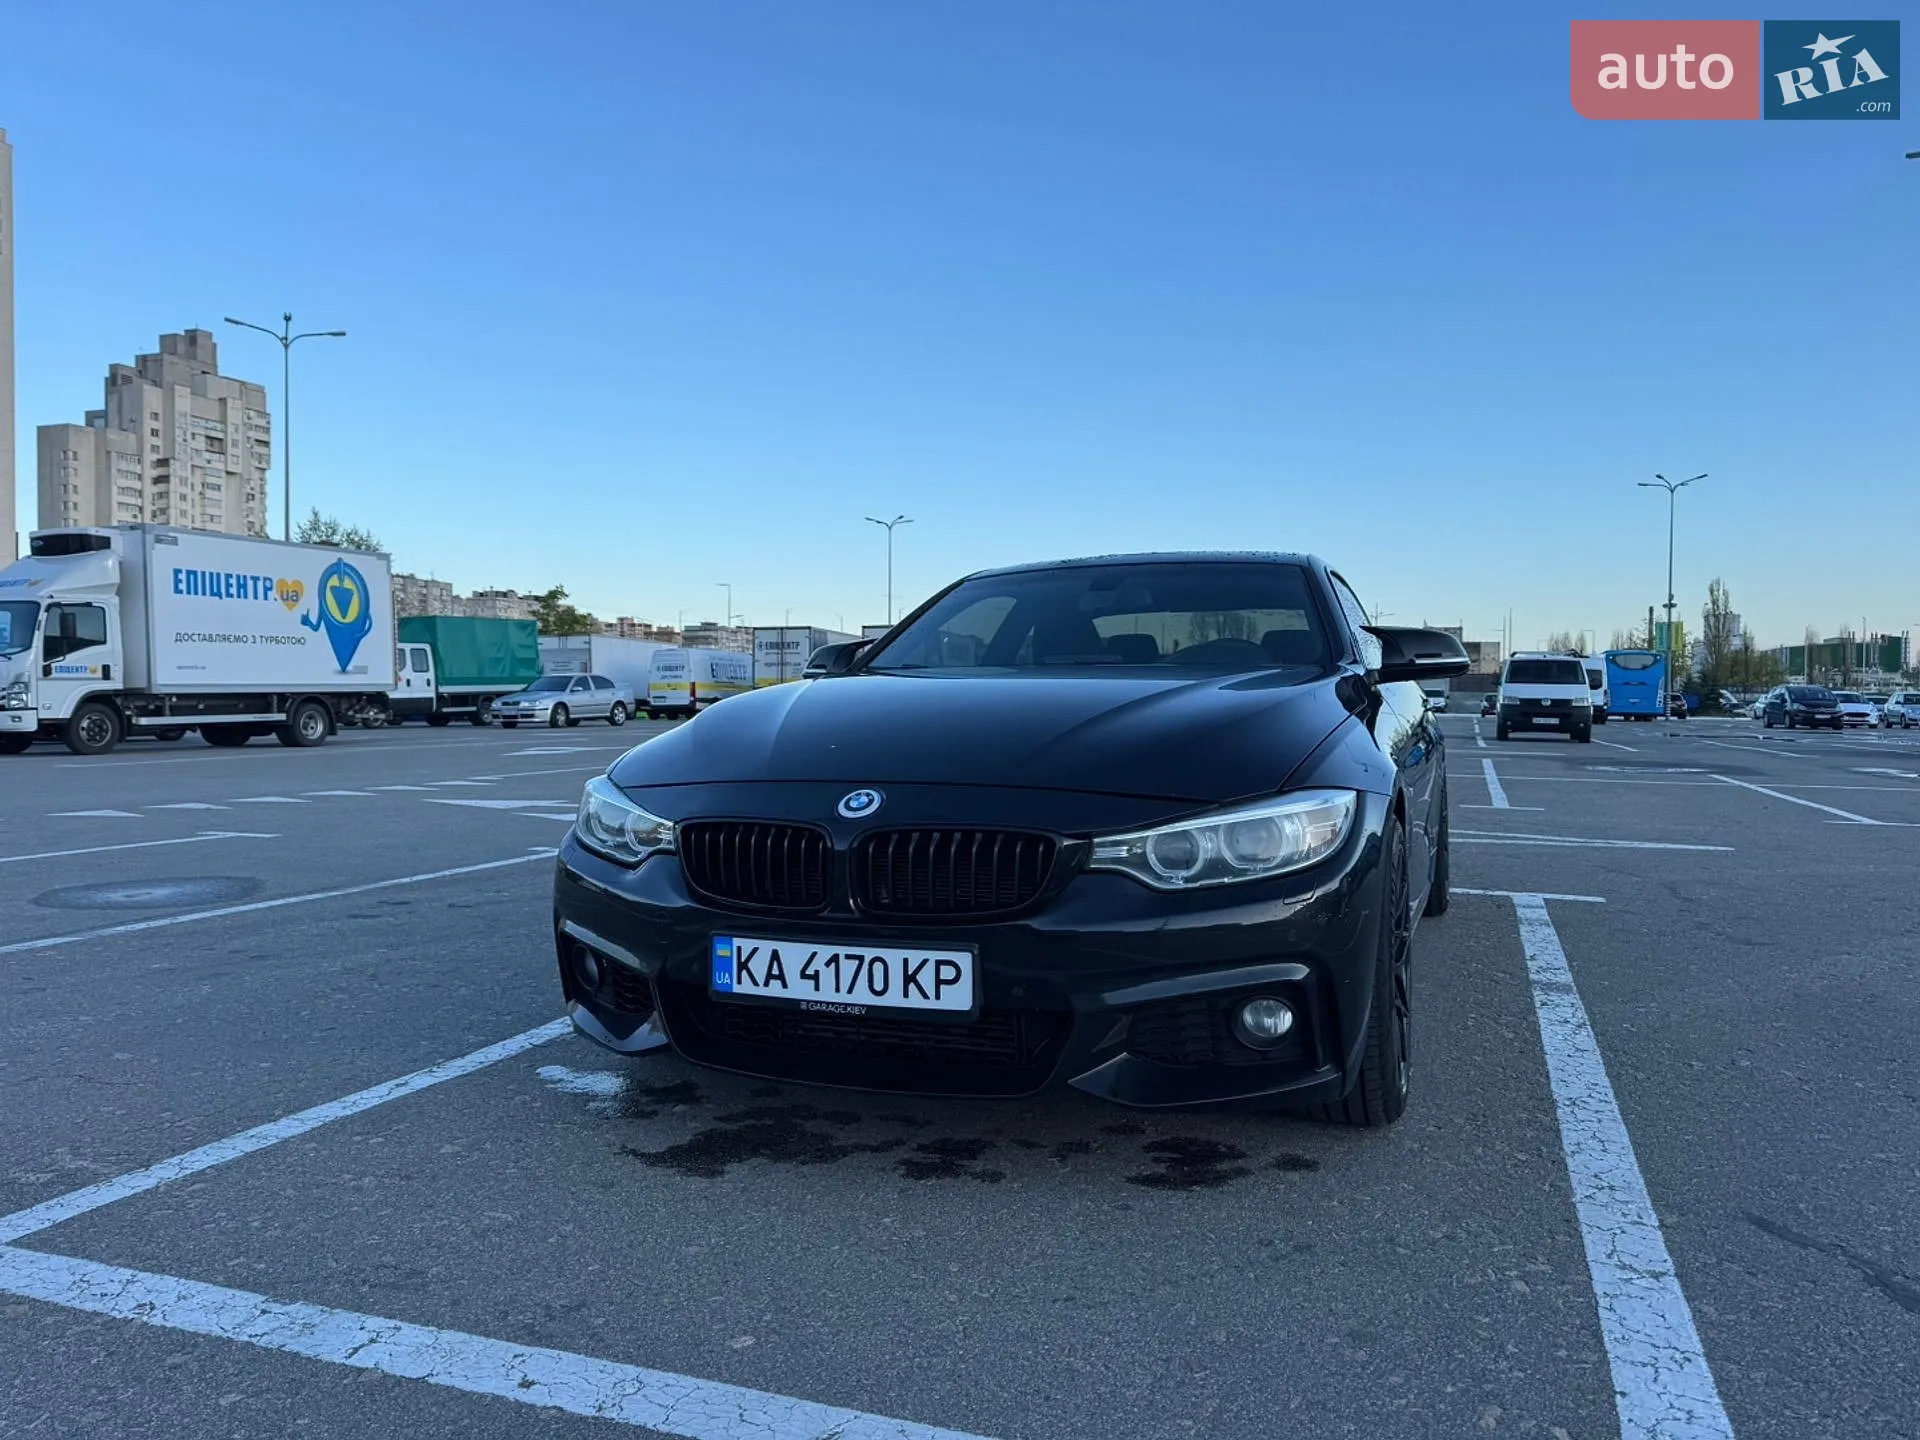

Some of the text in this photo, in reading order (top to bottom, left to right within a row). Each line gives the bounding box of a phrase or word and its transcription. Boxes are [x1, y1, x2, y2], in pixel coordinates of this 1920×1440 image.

[259, 635, 307, 646] ТУРБОТОЮ
[715, 971, 732, 985] UA
[735, 945, 963, 1001] KA 4170 KP
